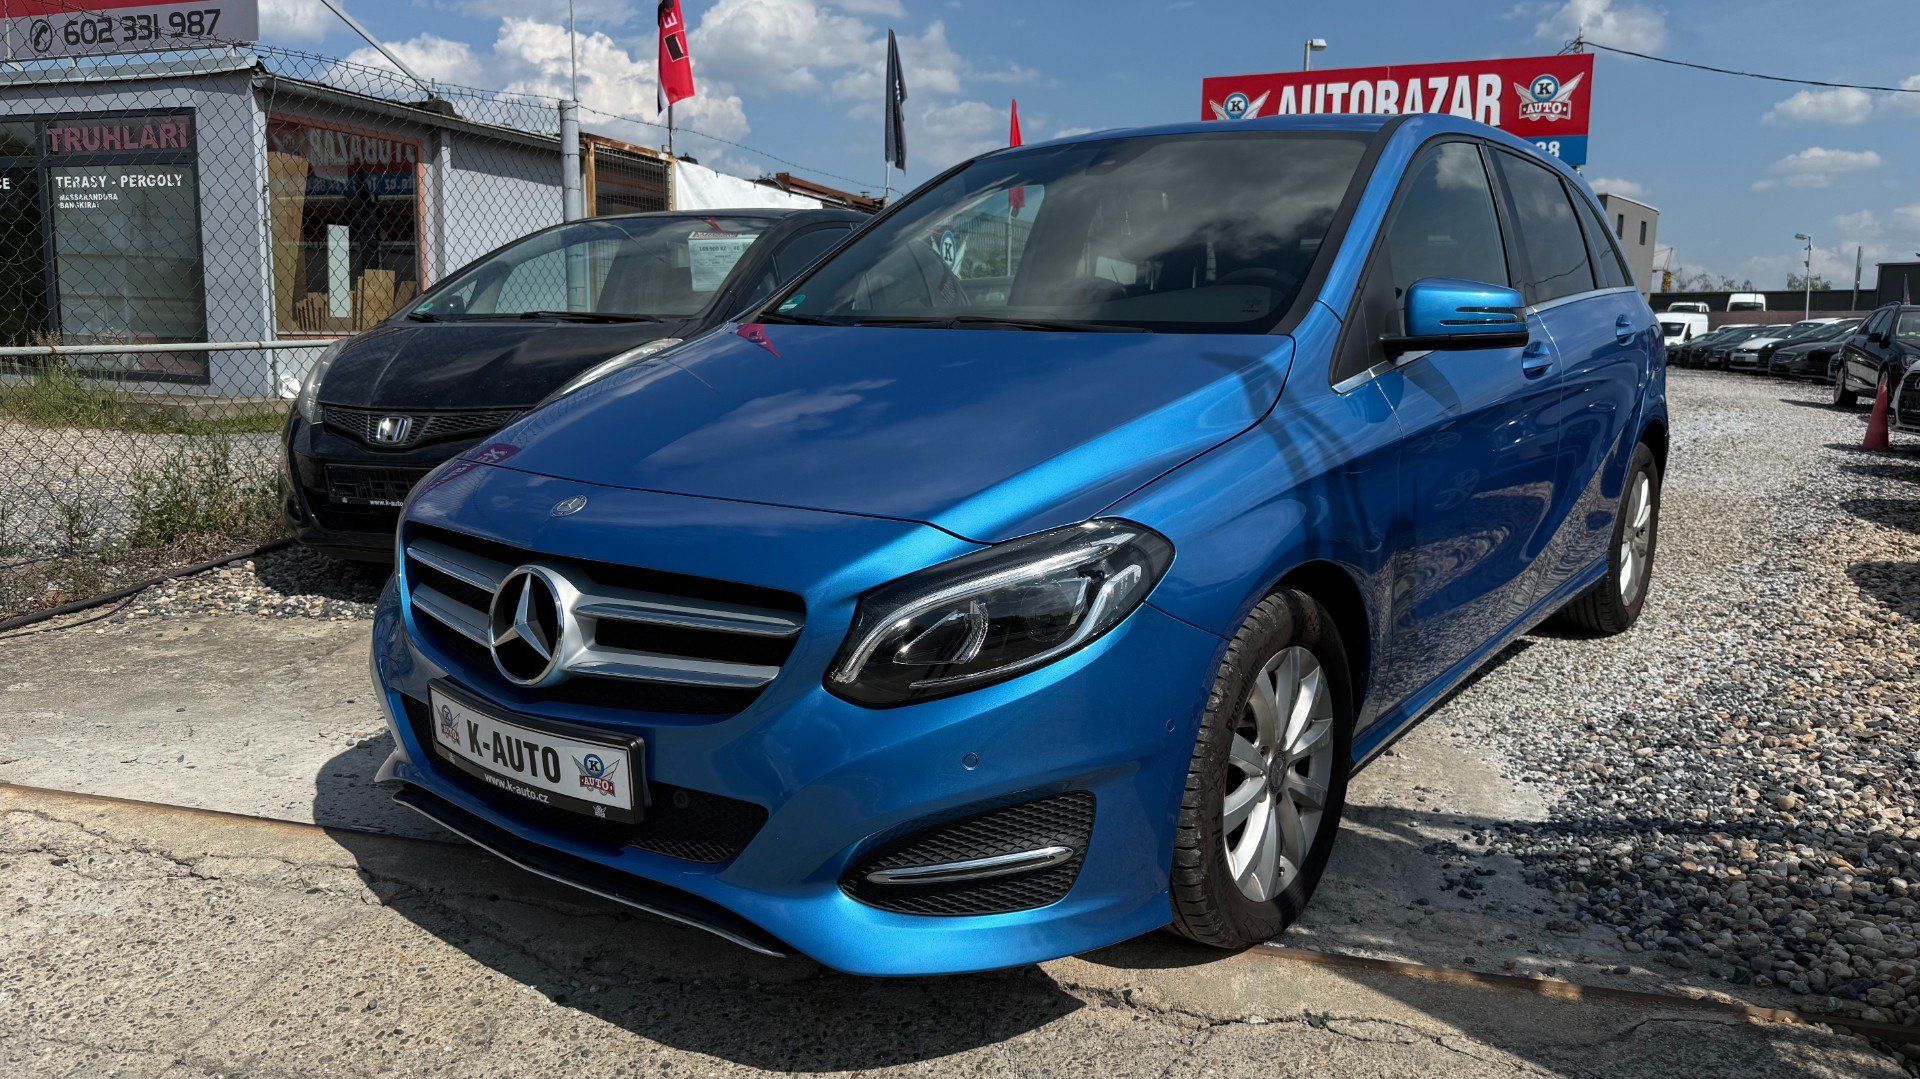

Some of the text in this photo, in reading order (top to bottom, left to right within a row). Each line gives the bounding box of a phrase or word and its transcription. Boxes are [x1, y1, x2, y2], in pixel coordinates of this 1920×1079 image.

[64, 9, 221, 46] 602 331 987
[1537, 82, 1552, 95] K
[1277, 73, 1502, 128] AUTOBAZAR
[1526, 102, 1562, 115] AUTO
[0, 177, 11, 190] E
[55, 175, 107, 188] TERASY
[120, 174, 183, 188] PERGOLY
[369, 499, 404, 507] www.k-auto
[466, 719, 562, 784] K-AUTO
[484, 773, 550, 804] www.k-auto.cz
[583, 776, 610, 791] AUTO
